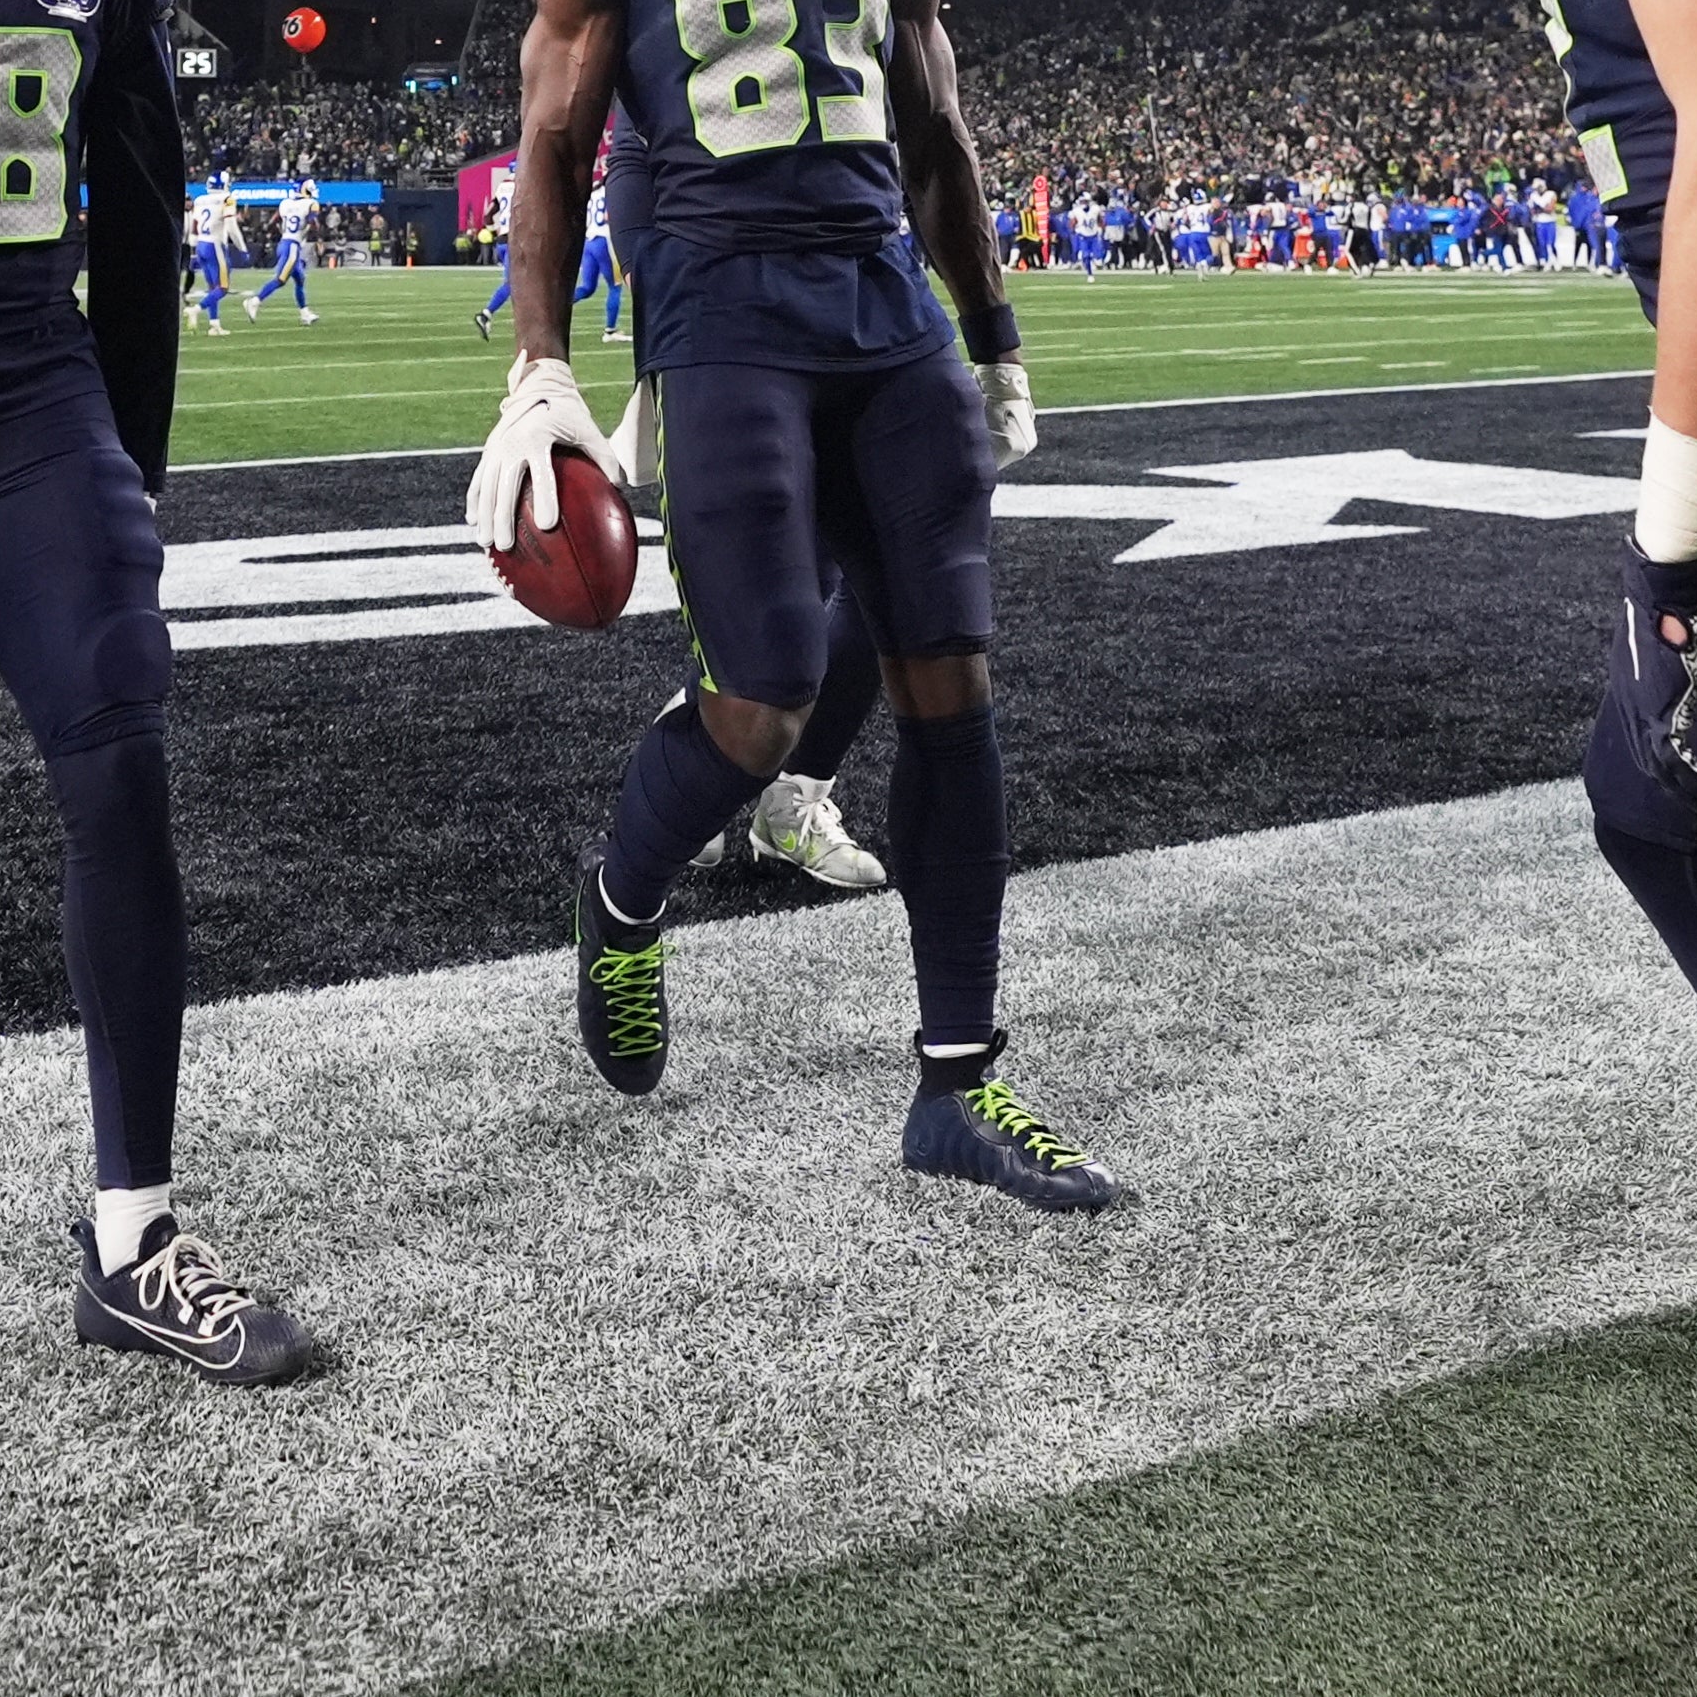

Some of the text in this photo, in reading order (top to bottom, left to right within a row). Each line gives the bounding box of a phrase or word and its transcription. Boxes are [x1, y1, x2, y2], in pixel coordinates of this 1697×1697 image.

[182, 51, 213, 75] 25
[232, 189, 289, 200] COLUMBIA
[200, 208, 212, 235] 2
